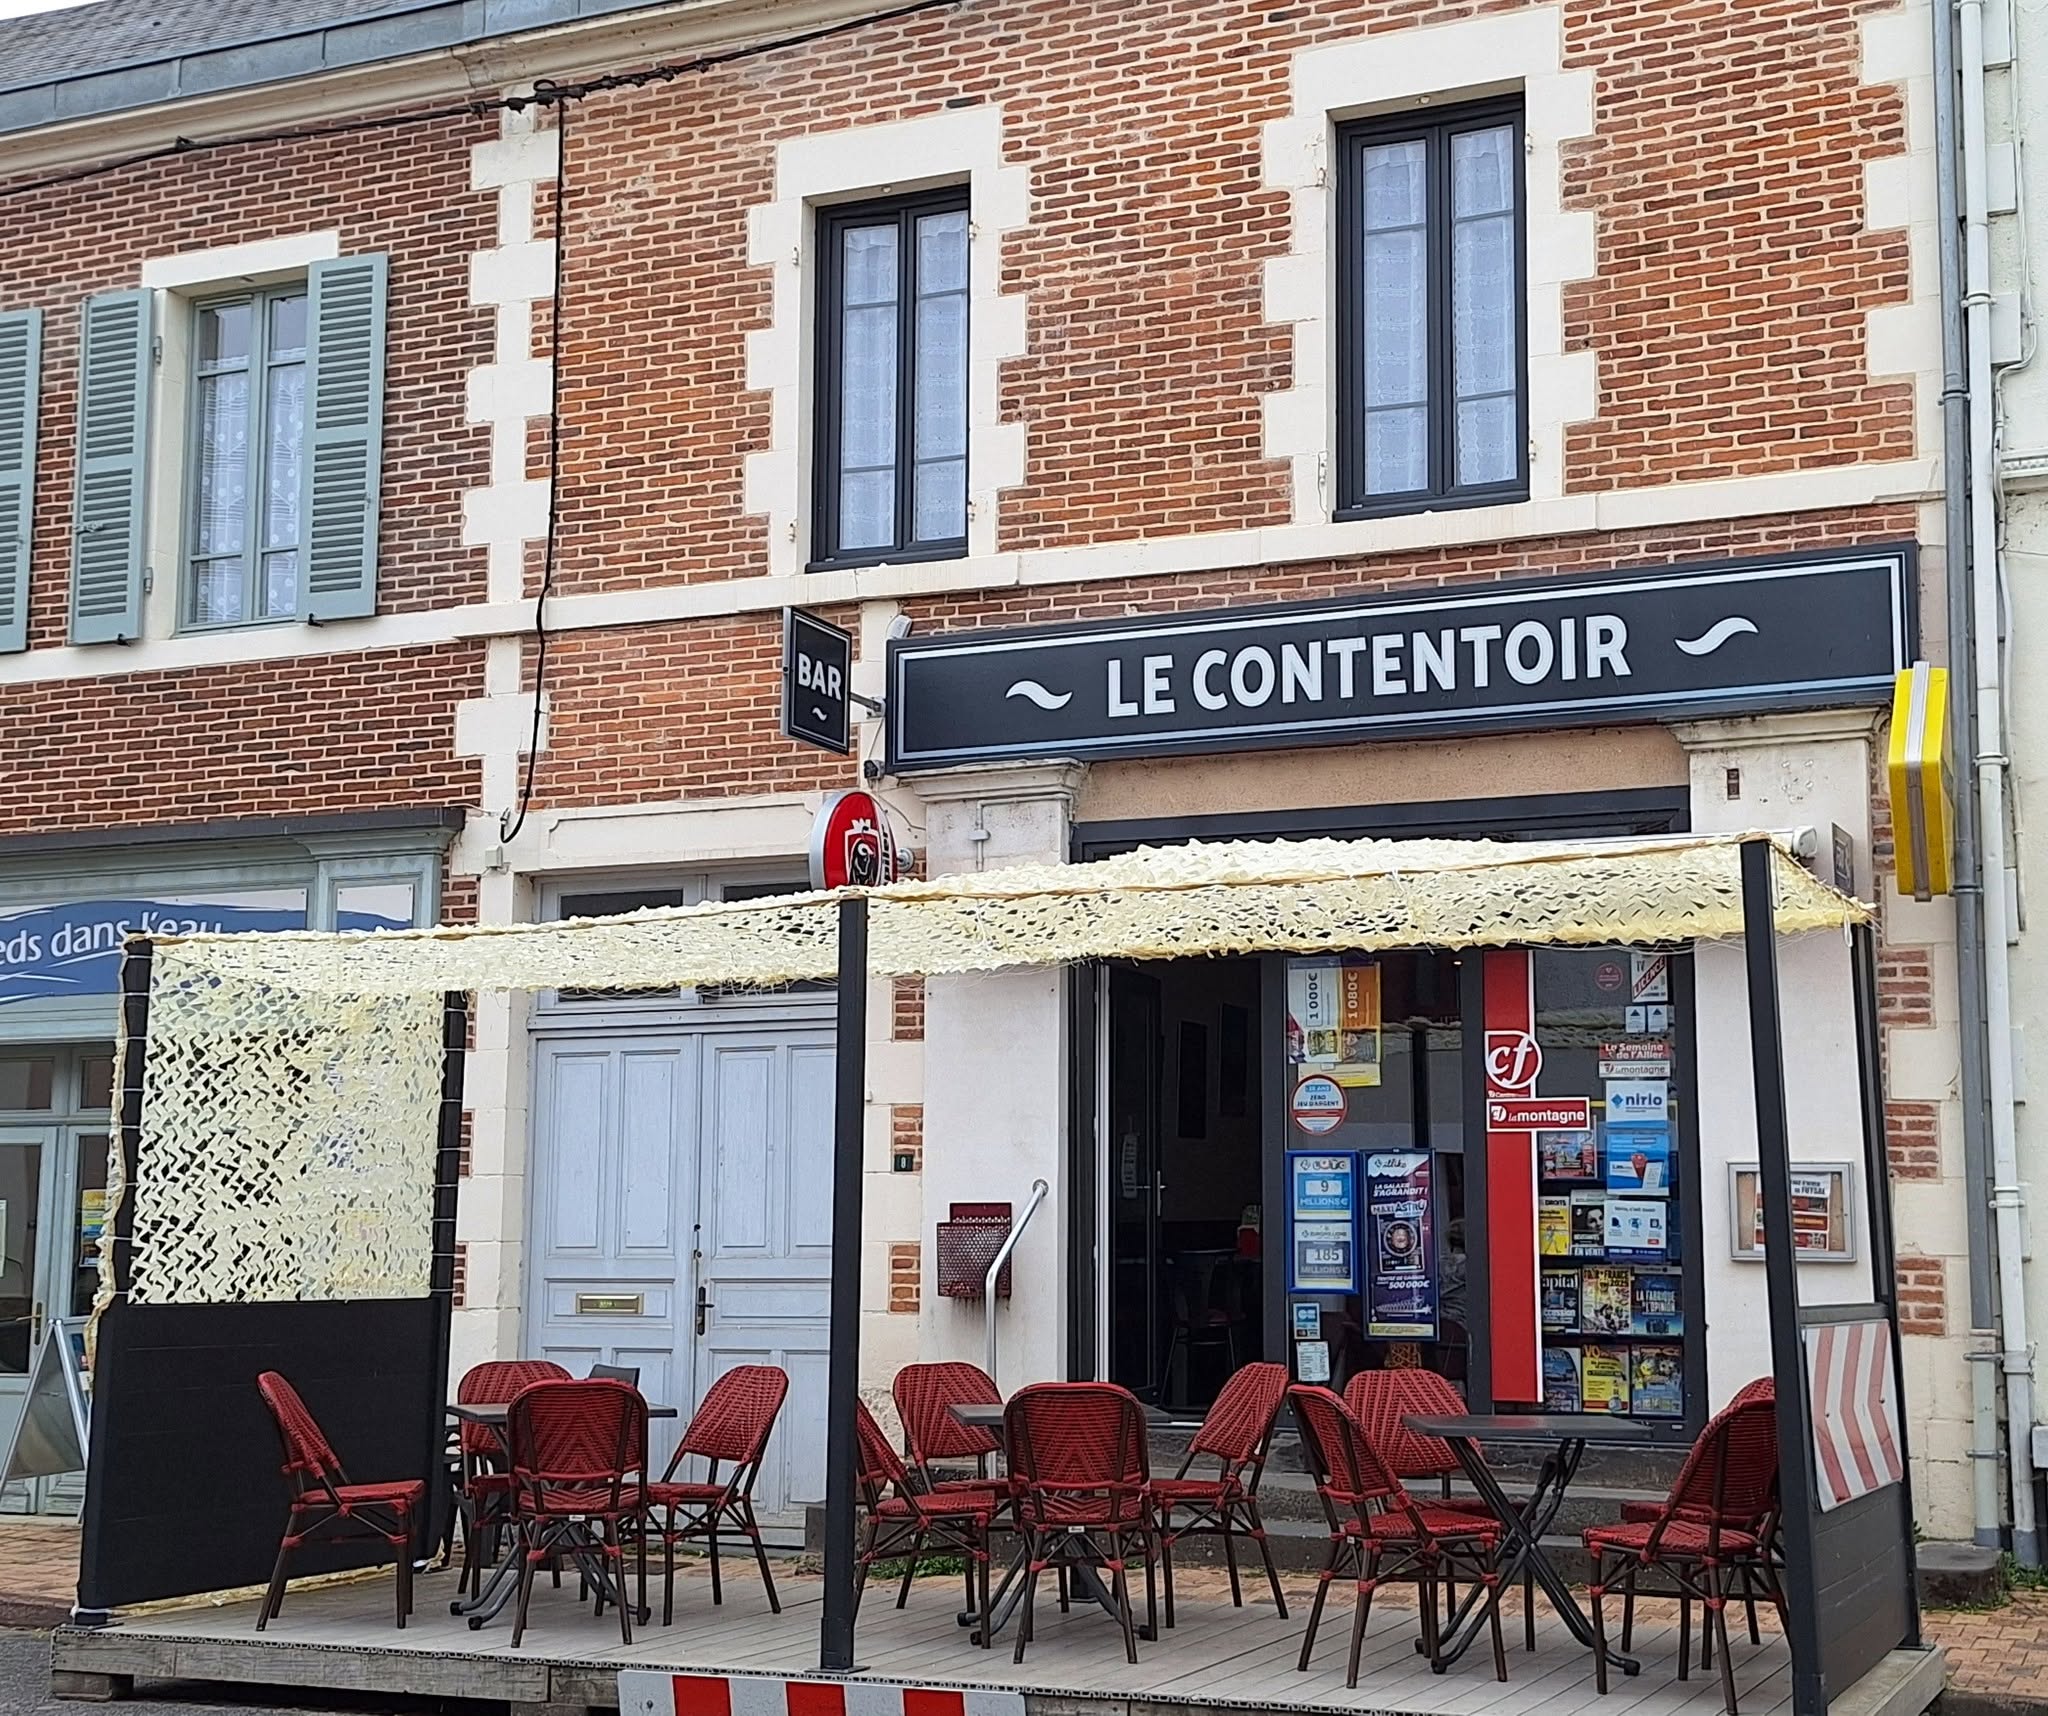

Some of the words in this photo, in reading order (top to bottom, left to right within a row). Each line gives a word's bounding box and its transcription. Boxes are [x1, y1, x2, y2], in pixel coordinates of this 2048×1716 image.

[1107, 654, 1176, 718] LE
[1192, 614, 1633, 711] CONTENTOIR
[798, 652, 843, 700] BAR
[0, 929, 42, 965] ds
[51, 919, 131, 958] dans
[1633, 955, 1666, 999] LICENCE
[1620, 1043, 1664, 1052] Semaine
[1616, 1051, 1630, 1059] de
[1631, 1051, 1663, 1059] l'Allier
[1621, 1066, 1665, 1074] montagne
[1625, 1092, 1662, 1106] nirio
[1517, 1109, 1585, 1124] montagne
[1320, 1180, 1329, 1192] 9
[1315, 1249, 1339, 1260] 185
[1604, 1270, 1628, 1279] FRANCE
[1541, 1273, 1578, 1292] apital
